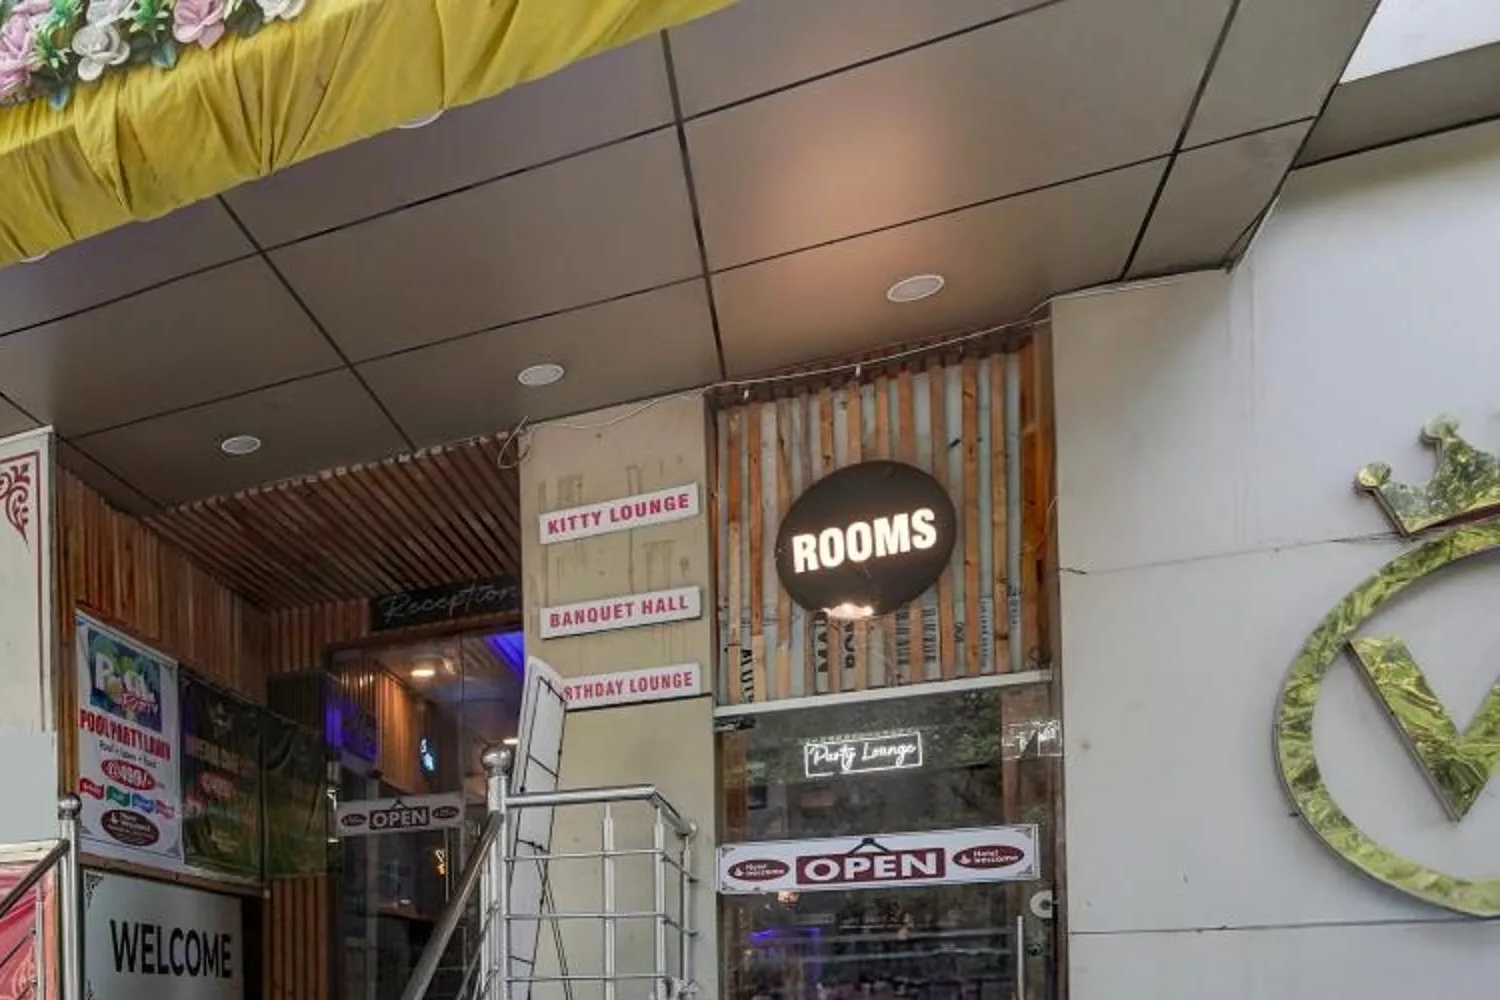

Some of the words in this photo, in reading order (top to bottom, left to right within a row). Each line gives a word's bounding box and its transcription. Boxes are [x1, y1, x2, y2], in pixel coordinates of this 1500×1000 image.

[547, 511, 602, 535] KITTY
[609, 493, 690, 523] LOUNGE
[792, 507, 937, 574] ROOMS
[550, 602, 635, 629] BANQUET
[641, 595, 689, 615] HALL
[629, 671, 694, 693] LOUNGE
[808, 743, 857, 771] Party
[861, 741, 917, 768] Lounge
[372, 806, 428, 829] OPEN
[804, 851, 938, 882] OPEN
[109, 918, 233, 979] WELCOME
